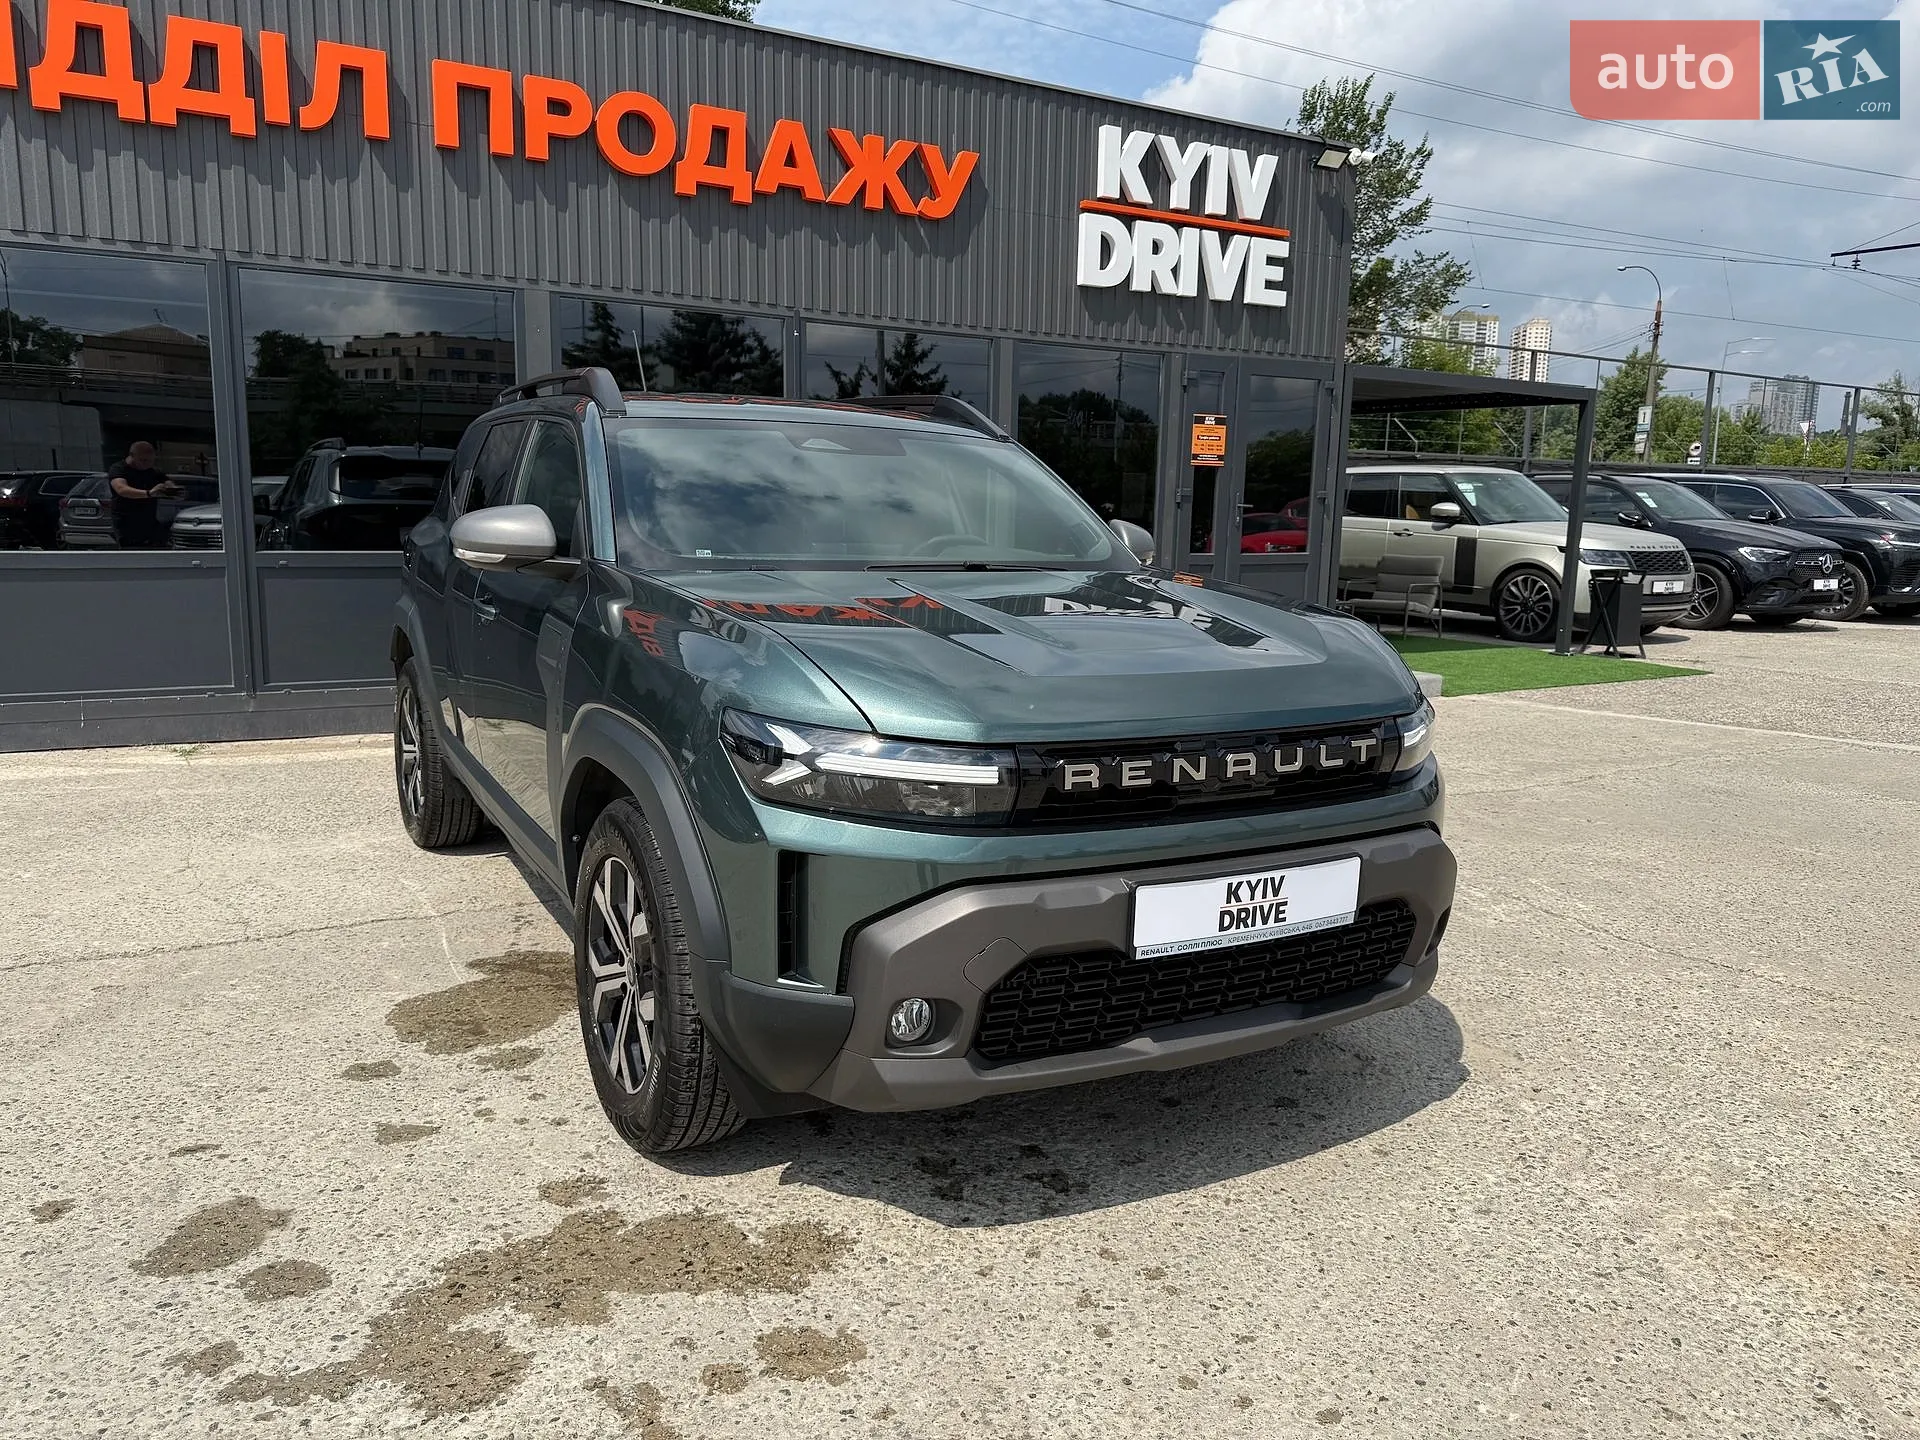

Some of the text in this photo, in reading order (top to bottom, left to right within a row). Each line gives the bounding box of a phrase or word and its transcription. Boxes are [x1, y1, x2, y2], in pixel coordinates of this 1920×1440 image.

[432, 58, 980, 220] ПРОДАЖУ
[1097, 124, 1279, 221] KYIV
[1077, 212, 1290, 308] DRIVE
[1063, 737, 1378, 790] RENAULT
[1218, 900, 1289, 932] DRIVE
[1226, 875, 1286, 904] KYIV
[1140, 945, 1174, 957] RENAULT
